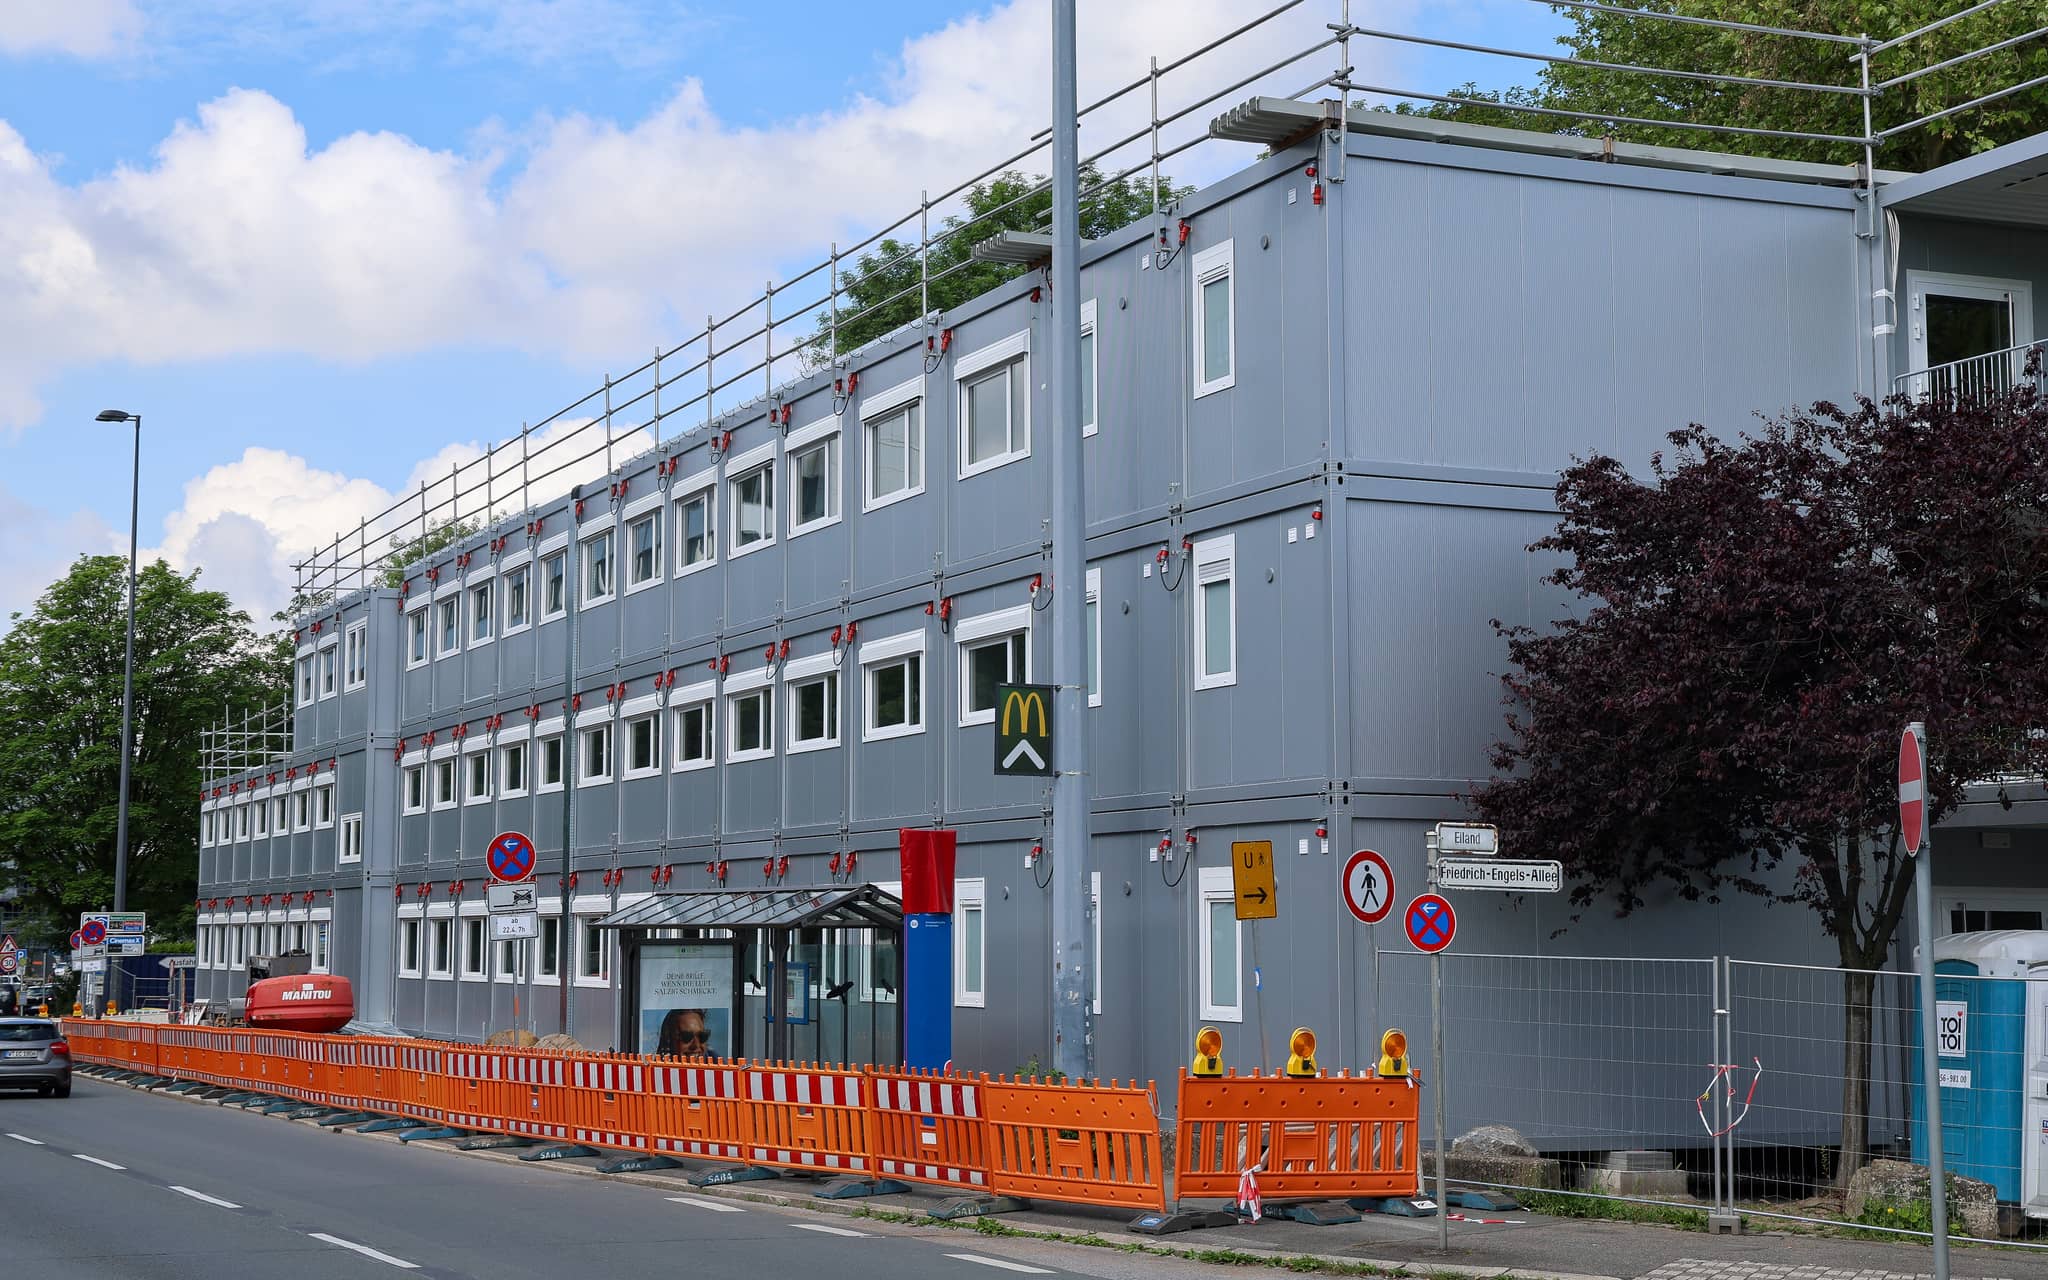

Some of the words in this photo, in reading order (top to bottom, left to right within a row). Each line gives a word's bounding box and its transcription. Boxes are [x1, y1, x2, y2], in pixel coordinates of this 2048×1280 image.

[1454, 832, 1481, 845] Eiland
[1244, 852, 1253, 869] U
[1440, 866, 1558, 884] Friedrich-Engels-Allee
[661, 980, 681, 988] WENN
[682, 980, 694, 988] DIE
[695, 980, 712, 988] LUFT
[282, 989, 332, 1001] MANITOU
[654, 988, 678, 996] SALZIG
[1940, 1034, 1961, 1050] TOI
[707, 1173, 733, 1184] SABA
